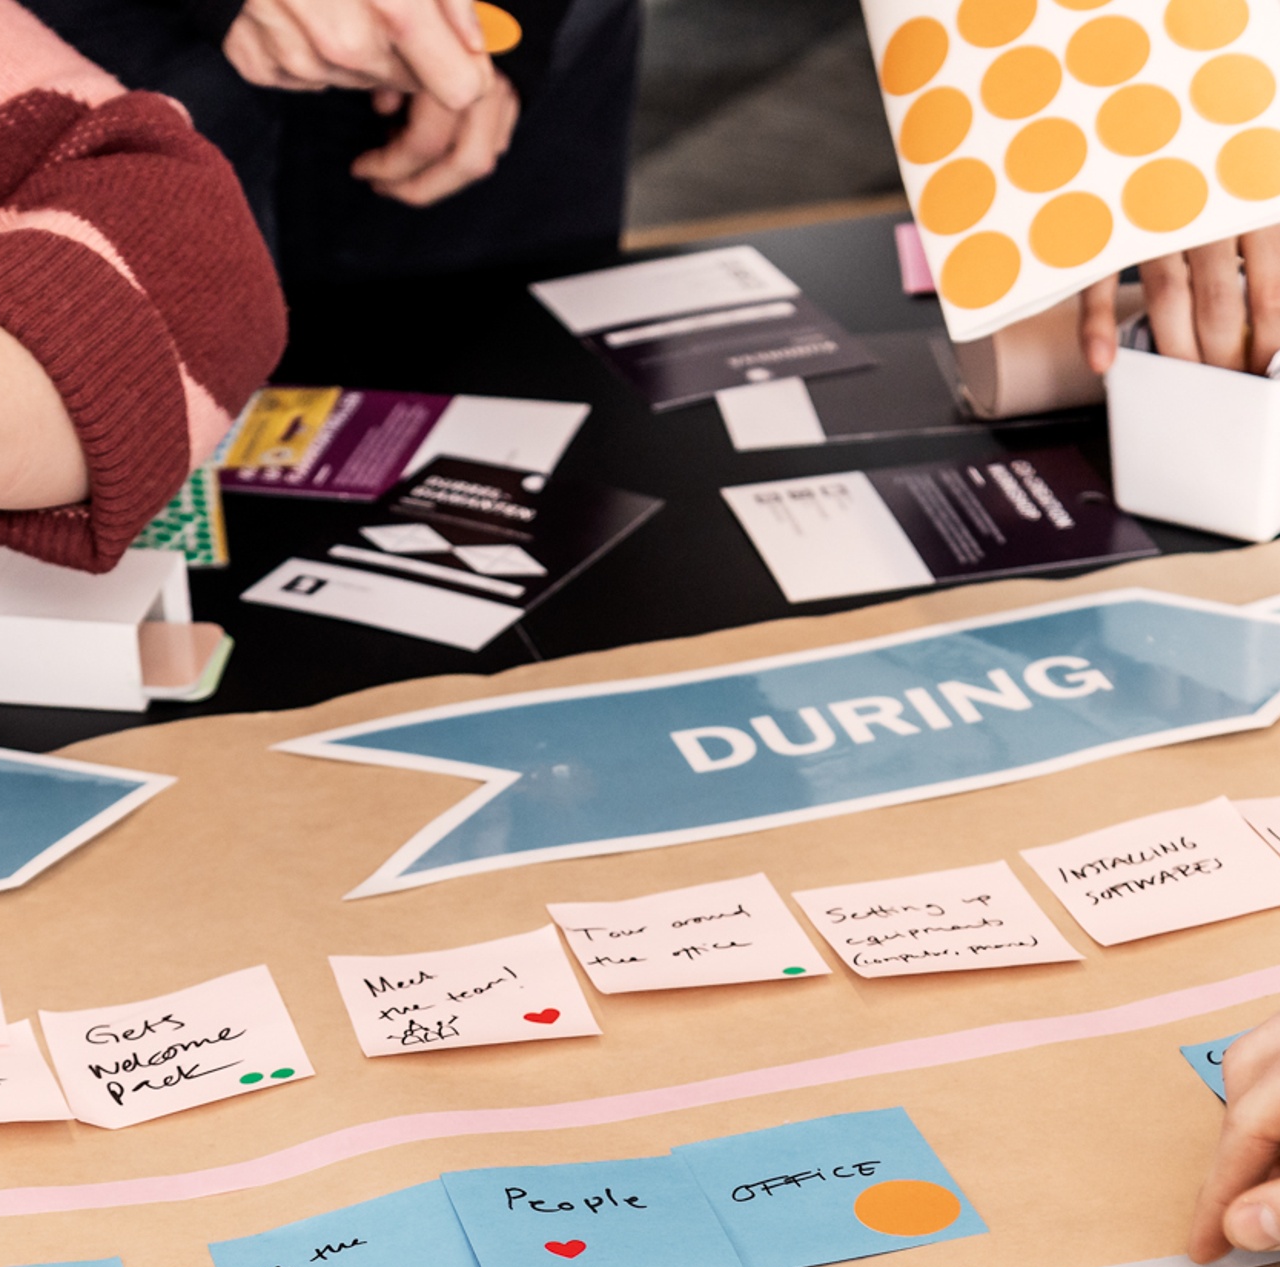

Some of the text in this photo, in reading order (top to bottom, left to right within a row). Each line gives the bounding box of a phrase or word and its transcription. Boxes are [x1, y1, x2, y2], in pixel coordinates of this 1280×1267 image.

[669, 655, 1115, 773] DURING
[567, 904, 751, 942] Tour around
[85, 1014, 185, 1045] Gets
